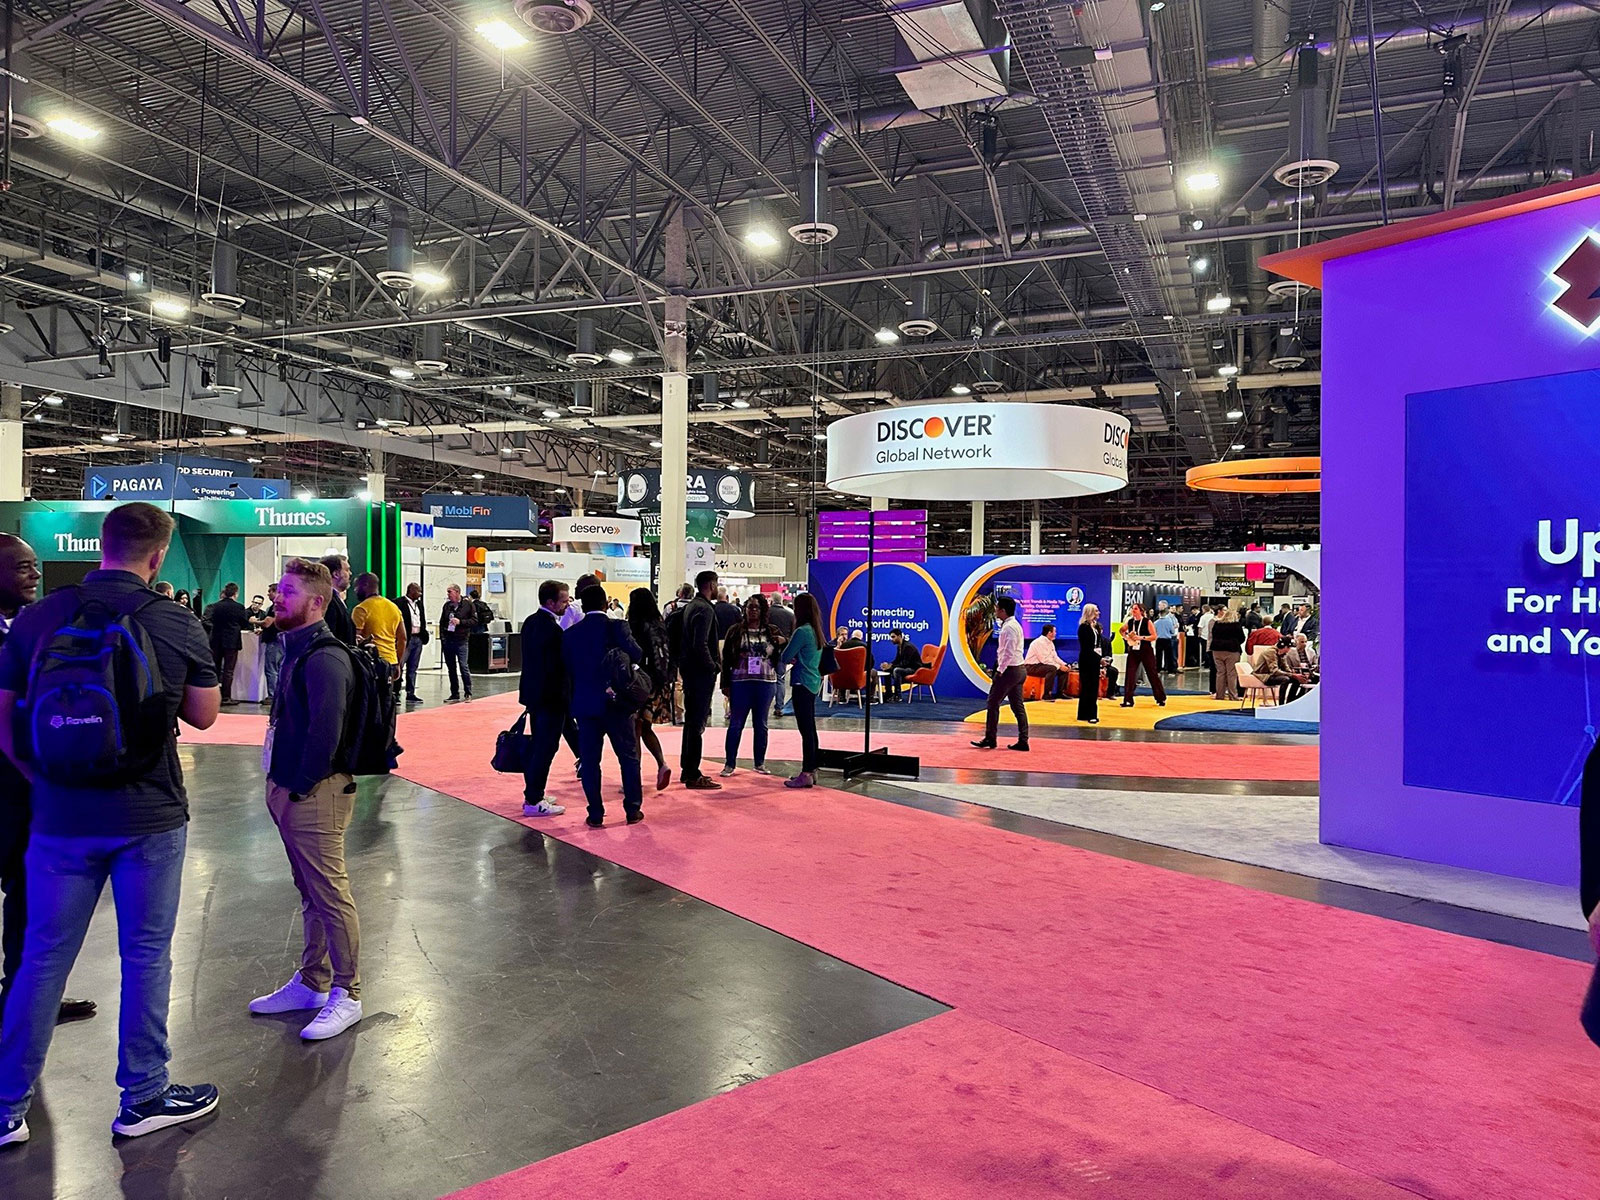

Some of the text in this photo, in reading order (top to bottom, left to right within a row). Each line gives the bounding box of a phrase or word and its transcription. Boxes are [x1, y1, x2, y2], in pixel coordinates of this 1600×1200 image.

[877, 414, 992, 442] DISCOVER
[876, 444, 992, 464] Global Network
[192, 467, 233, 477] SECURITY
[112, 478, 163, 492] PAGAYA
[201, 487, 235, 498] Powering
[445, 505, 491, 516] MobiFin
[255, 507, 331, 527] Thunes.
[405, 522, 433, 539] TRM
[570, 523, 614, 534] deserve
[440, 544, 460, 554] Crypto
[538, 561, 565, 569] MobiFin
[733, 562, 773, 570] YOULEND
[1506, 587, 1600, 613] For H
[848, 619, 863, 628] the
[892, 619, 929, 631] through
[1486, 627, 1600, 656] and Yo
